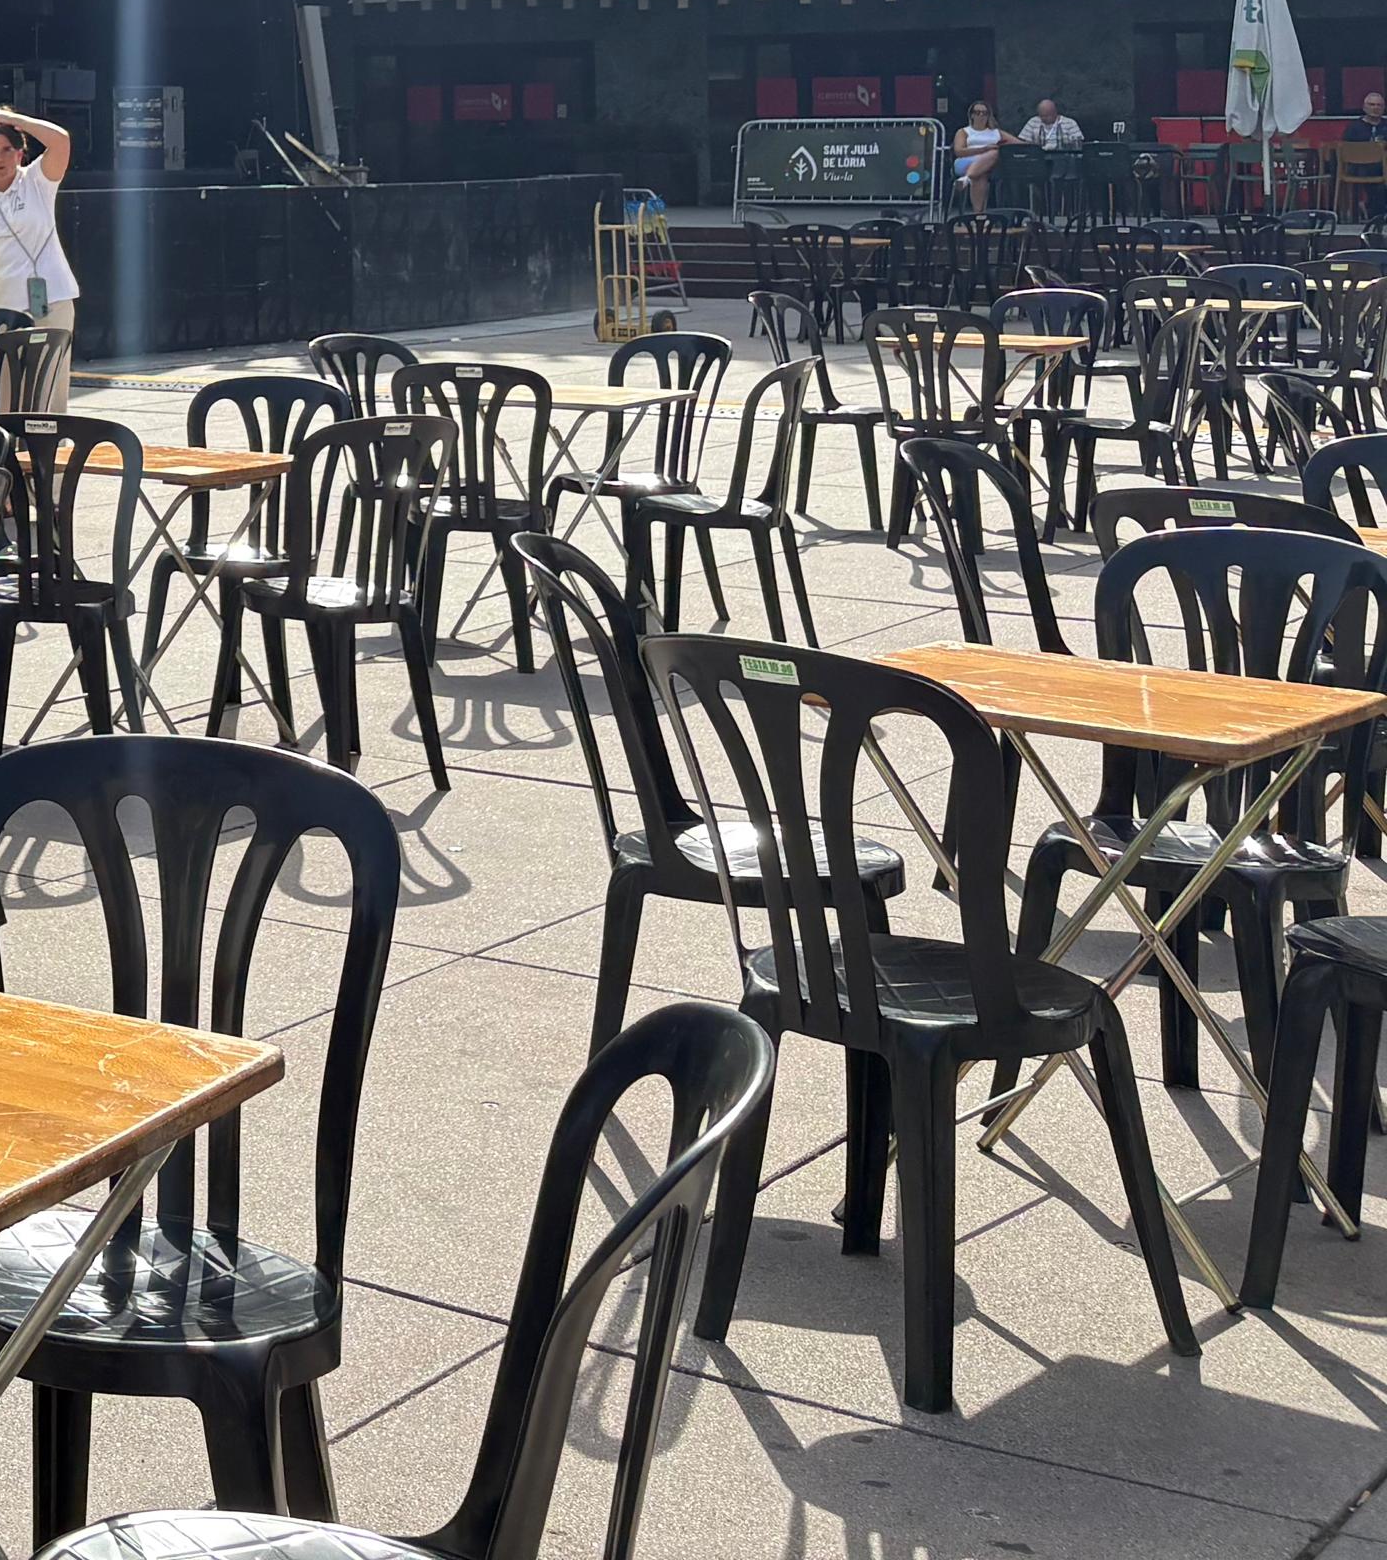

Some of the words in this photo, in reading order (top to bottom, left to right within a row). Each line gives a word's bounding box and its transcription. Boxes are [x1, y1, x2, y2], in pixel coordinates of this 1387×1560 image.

[823, 144, 848, 155] SANT
[850, 142, 880, 155] JULIÀ
[823, 158, 836, 168] DE
[838, 155, 866, 168] LÒRIA
[743, 657, 769, 672] FESTA
[769, 661, 780, 673] 10
